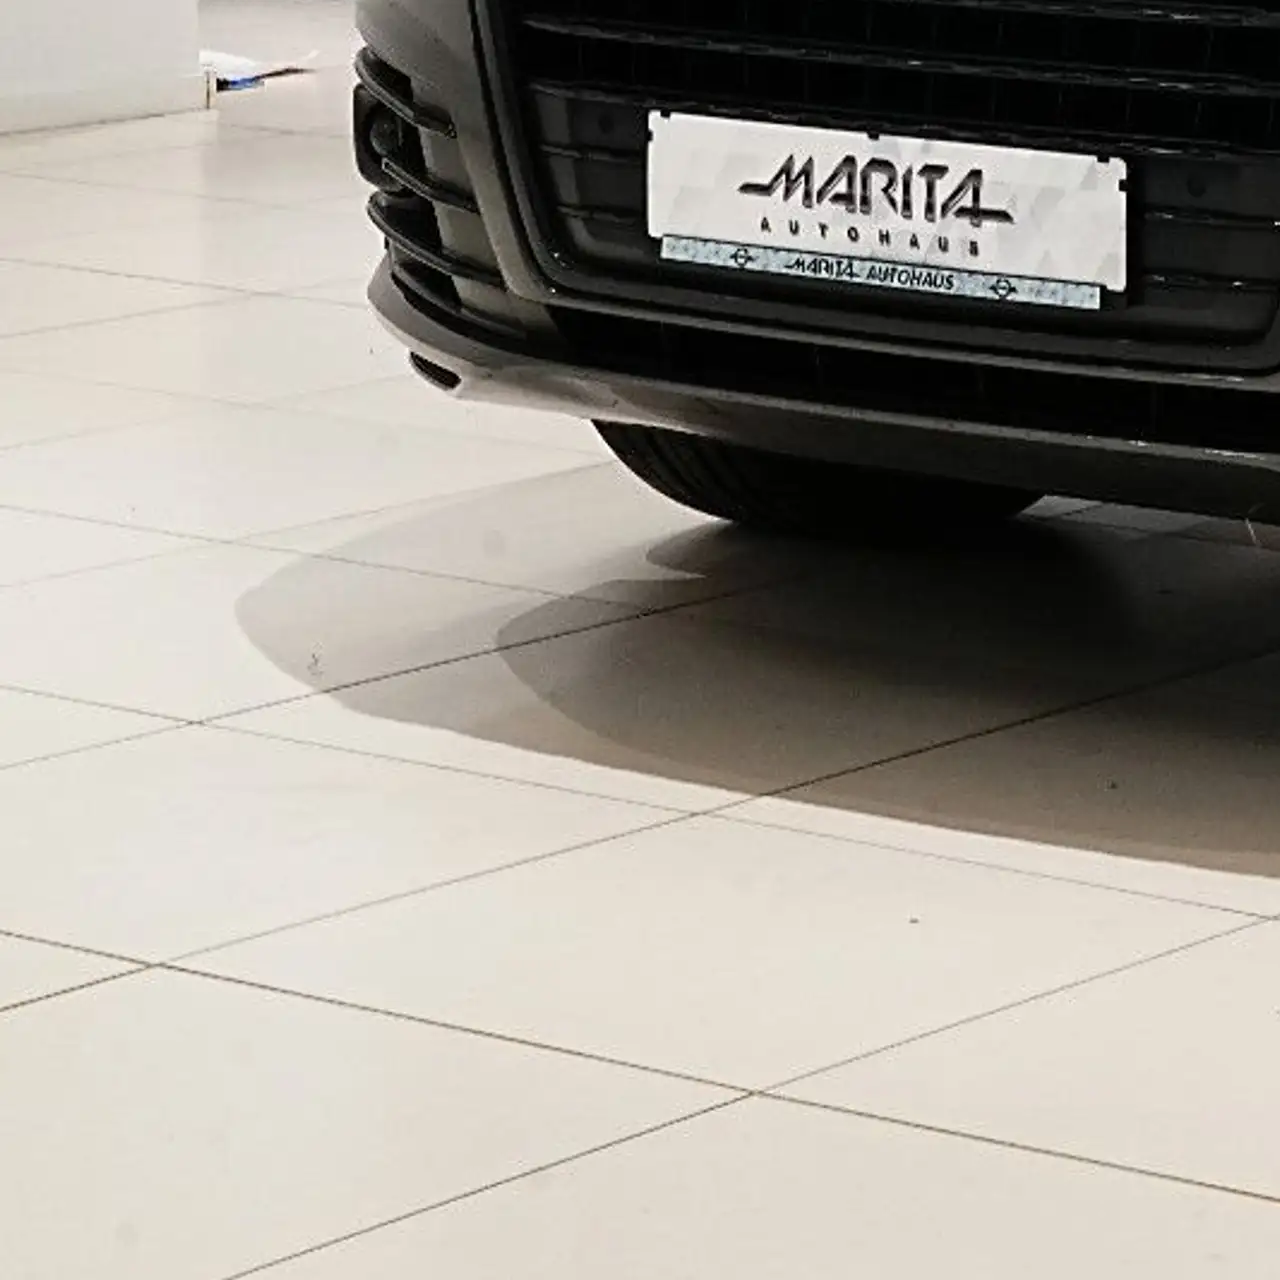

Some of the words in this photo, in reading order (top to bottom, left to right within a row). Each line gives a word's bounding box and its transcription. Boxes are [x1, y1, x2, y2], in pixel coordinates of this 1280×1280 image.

[737, 154, 1015, 228] MARITA
[760, 216, 980, 257] AUTOHAUS
[785, 257, 861, 279] MARITA
[866, 265, 955, 290] AUTOHAUS
